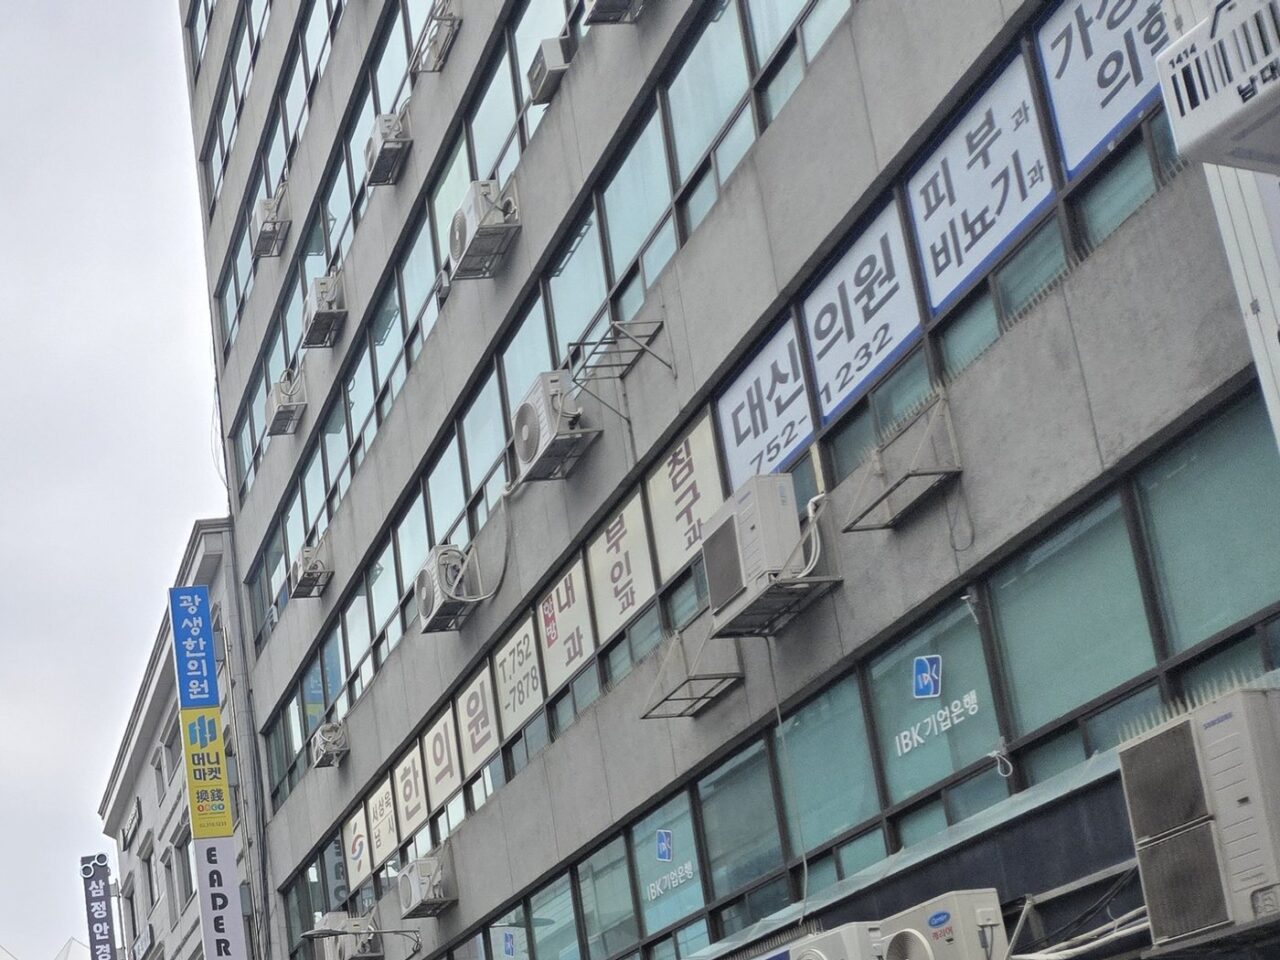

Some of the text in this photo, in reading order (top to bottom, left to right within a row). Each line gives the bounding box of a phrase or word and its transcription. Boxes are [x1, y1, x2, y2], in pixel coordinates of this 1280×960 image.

[930, 150, 1046, 279] 비뇨기과
[667, 437, 705, 552] 침구과
[605, 512, 637, 616] 부인과
[179, 593, 211, 700] 광생한의원
[191, 751, 221, 767] 머니
[193, 766, 222, 781] 마켓
